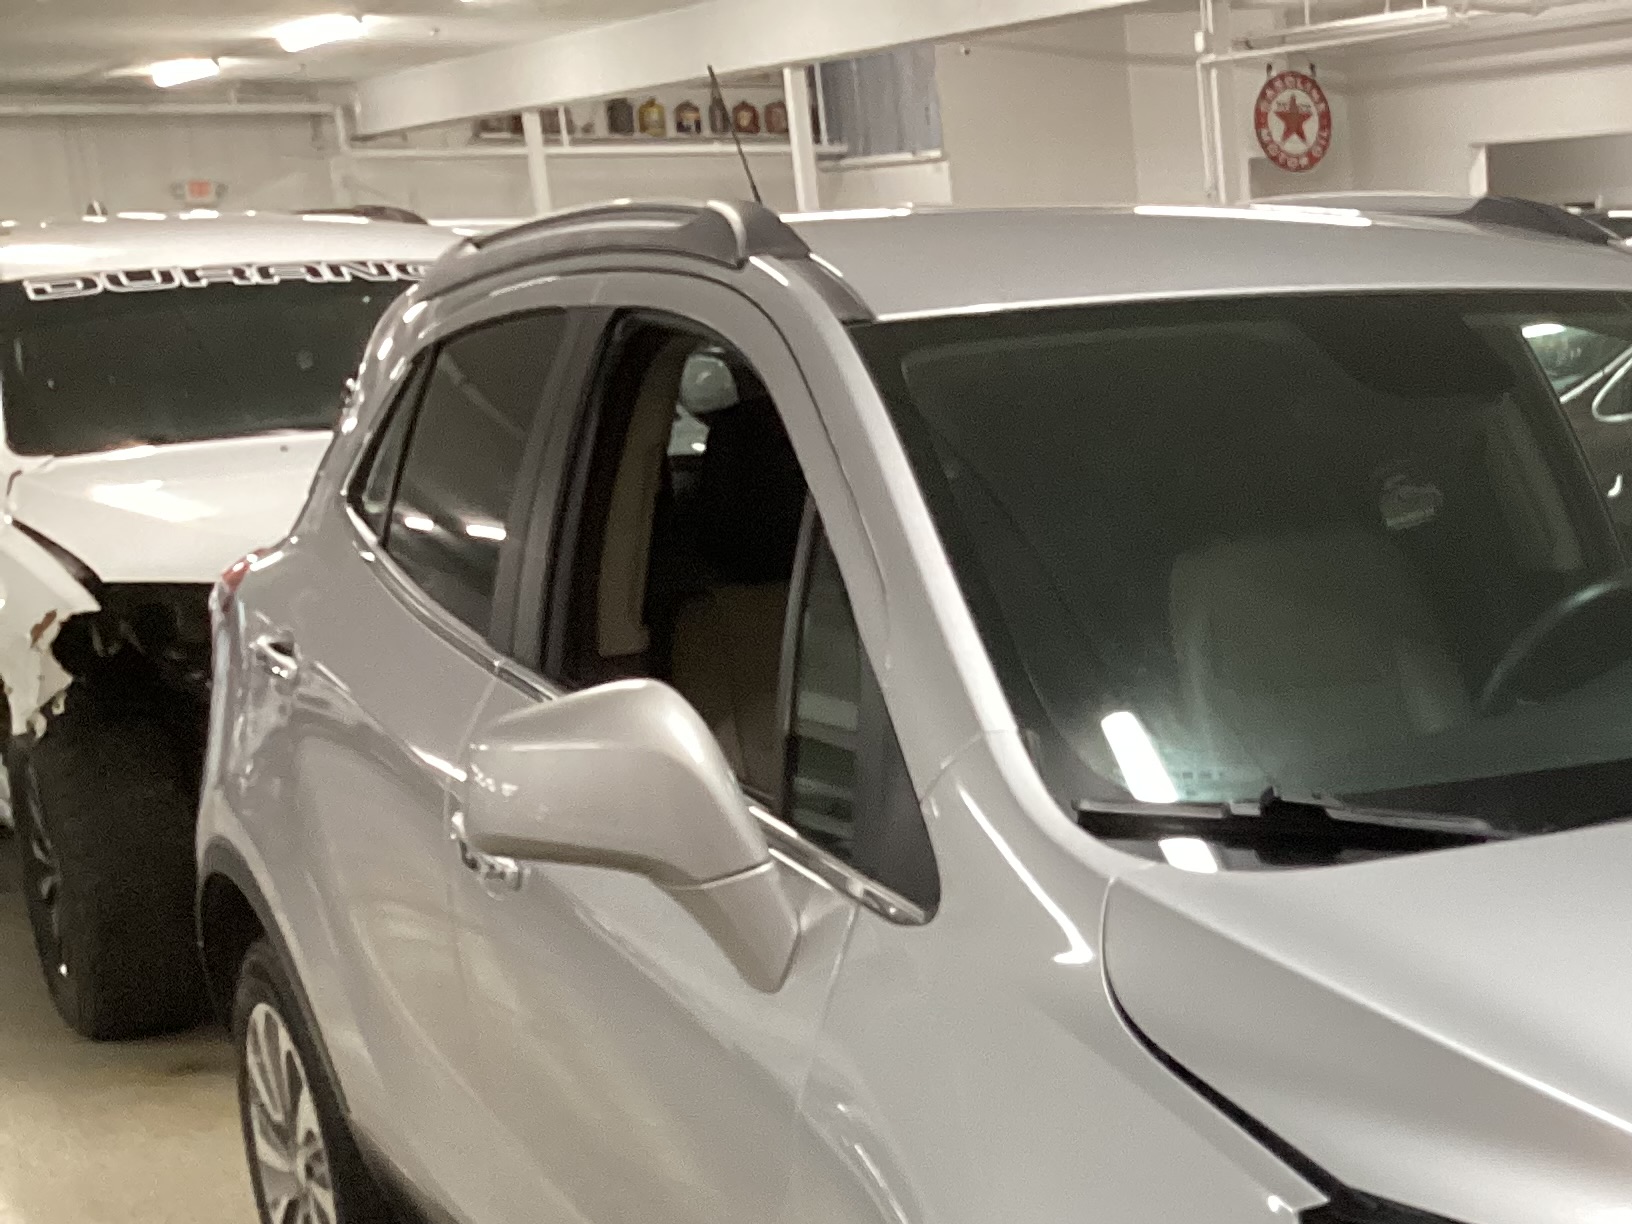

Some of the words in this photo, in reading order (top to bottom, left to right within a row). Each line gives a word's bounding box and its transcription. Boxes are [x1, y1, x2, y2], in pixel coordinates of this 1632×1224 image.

[1260, 75, 1327, 113] GASOLINE
[1260, 128, 1309, 169] MOTOR
[1311, 129, 1328, 158] OIL
